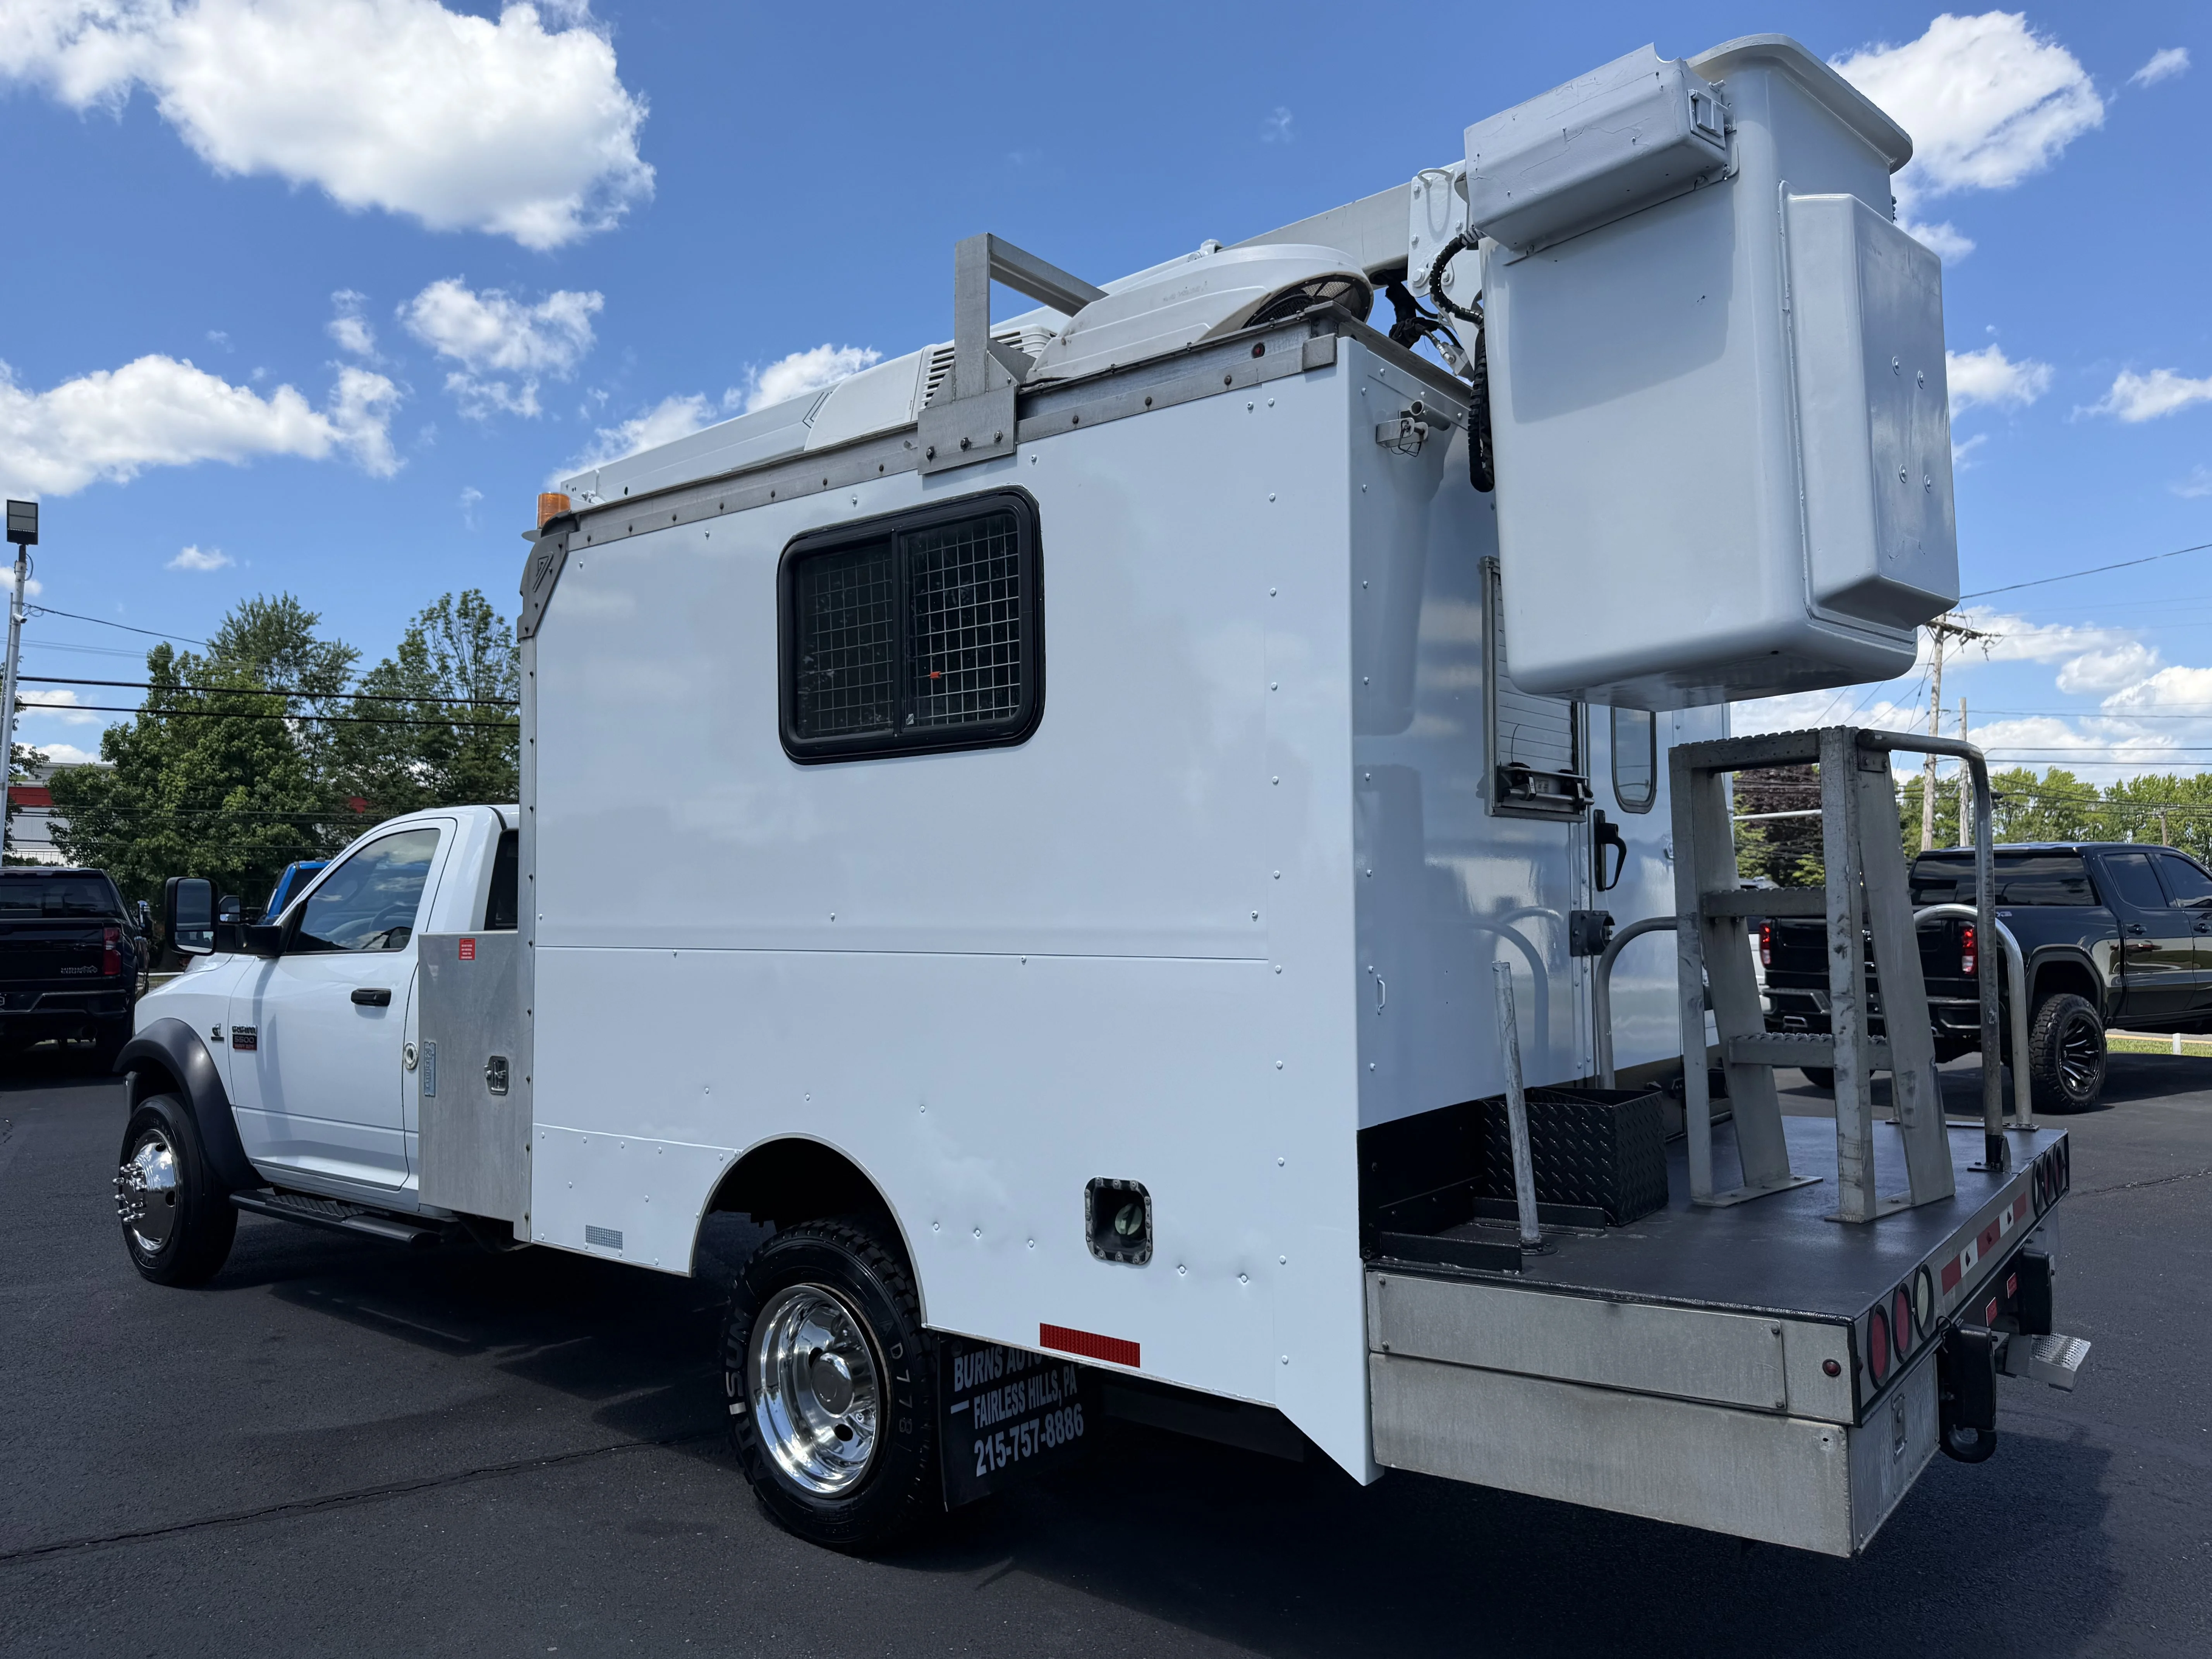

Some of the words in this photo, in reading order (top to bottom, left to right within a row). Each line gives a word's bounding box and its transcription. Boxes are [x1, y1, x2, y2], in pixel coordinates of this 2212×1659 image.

[232, 1025, 258, 1034] RAM
[725, 1308, 771, 1480] ARISUN
[954, 1345, 1003, 1392] BURNS
[974, 1380, 1025, 1429] FAIRLESS
[1027, 1369, 1062, 1410] HILLS,
[1063, 1364, 1077, 1397] PA
[974, 1403, 1084, 1477] 215-757-8886
